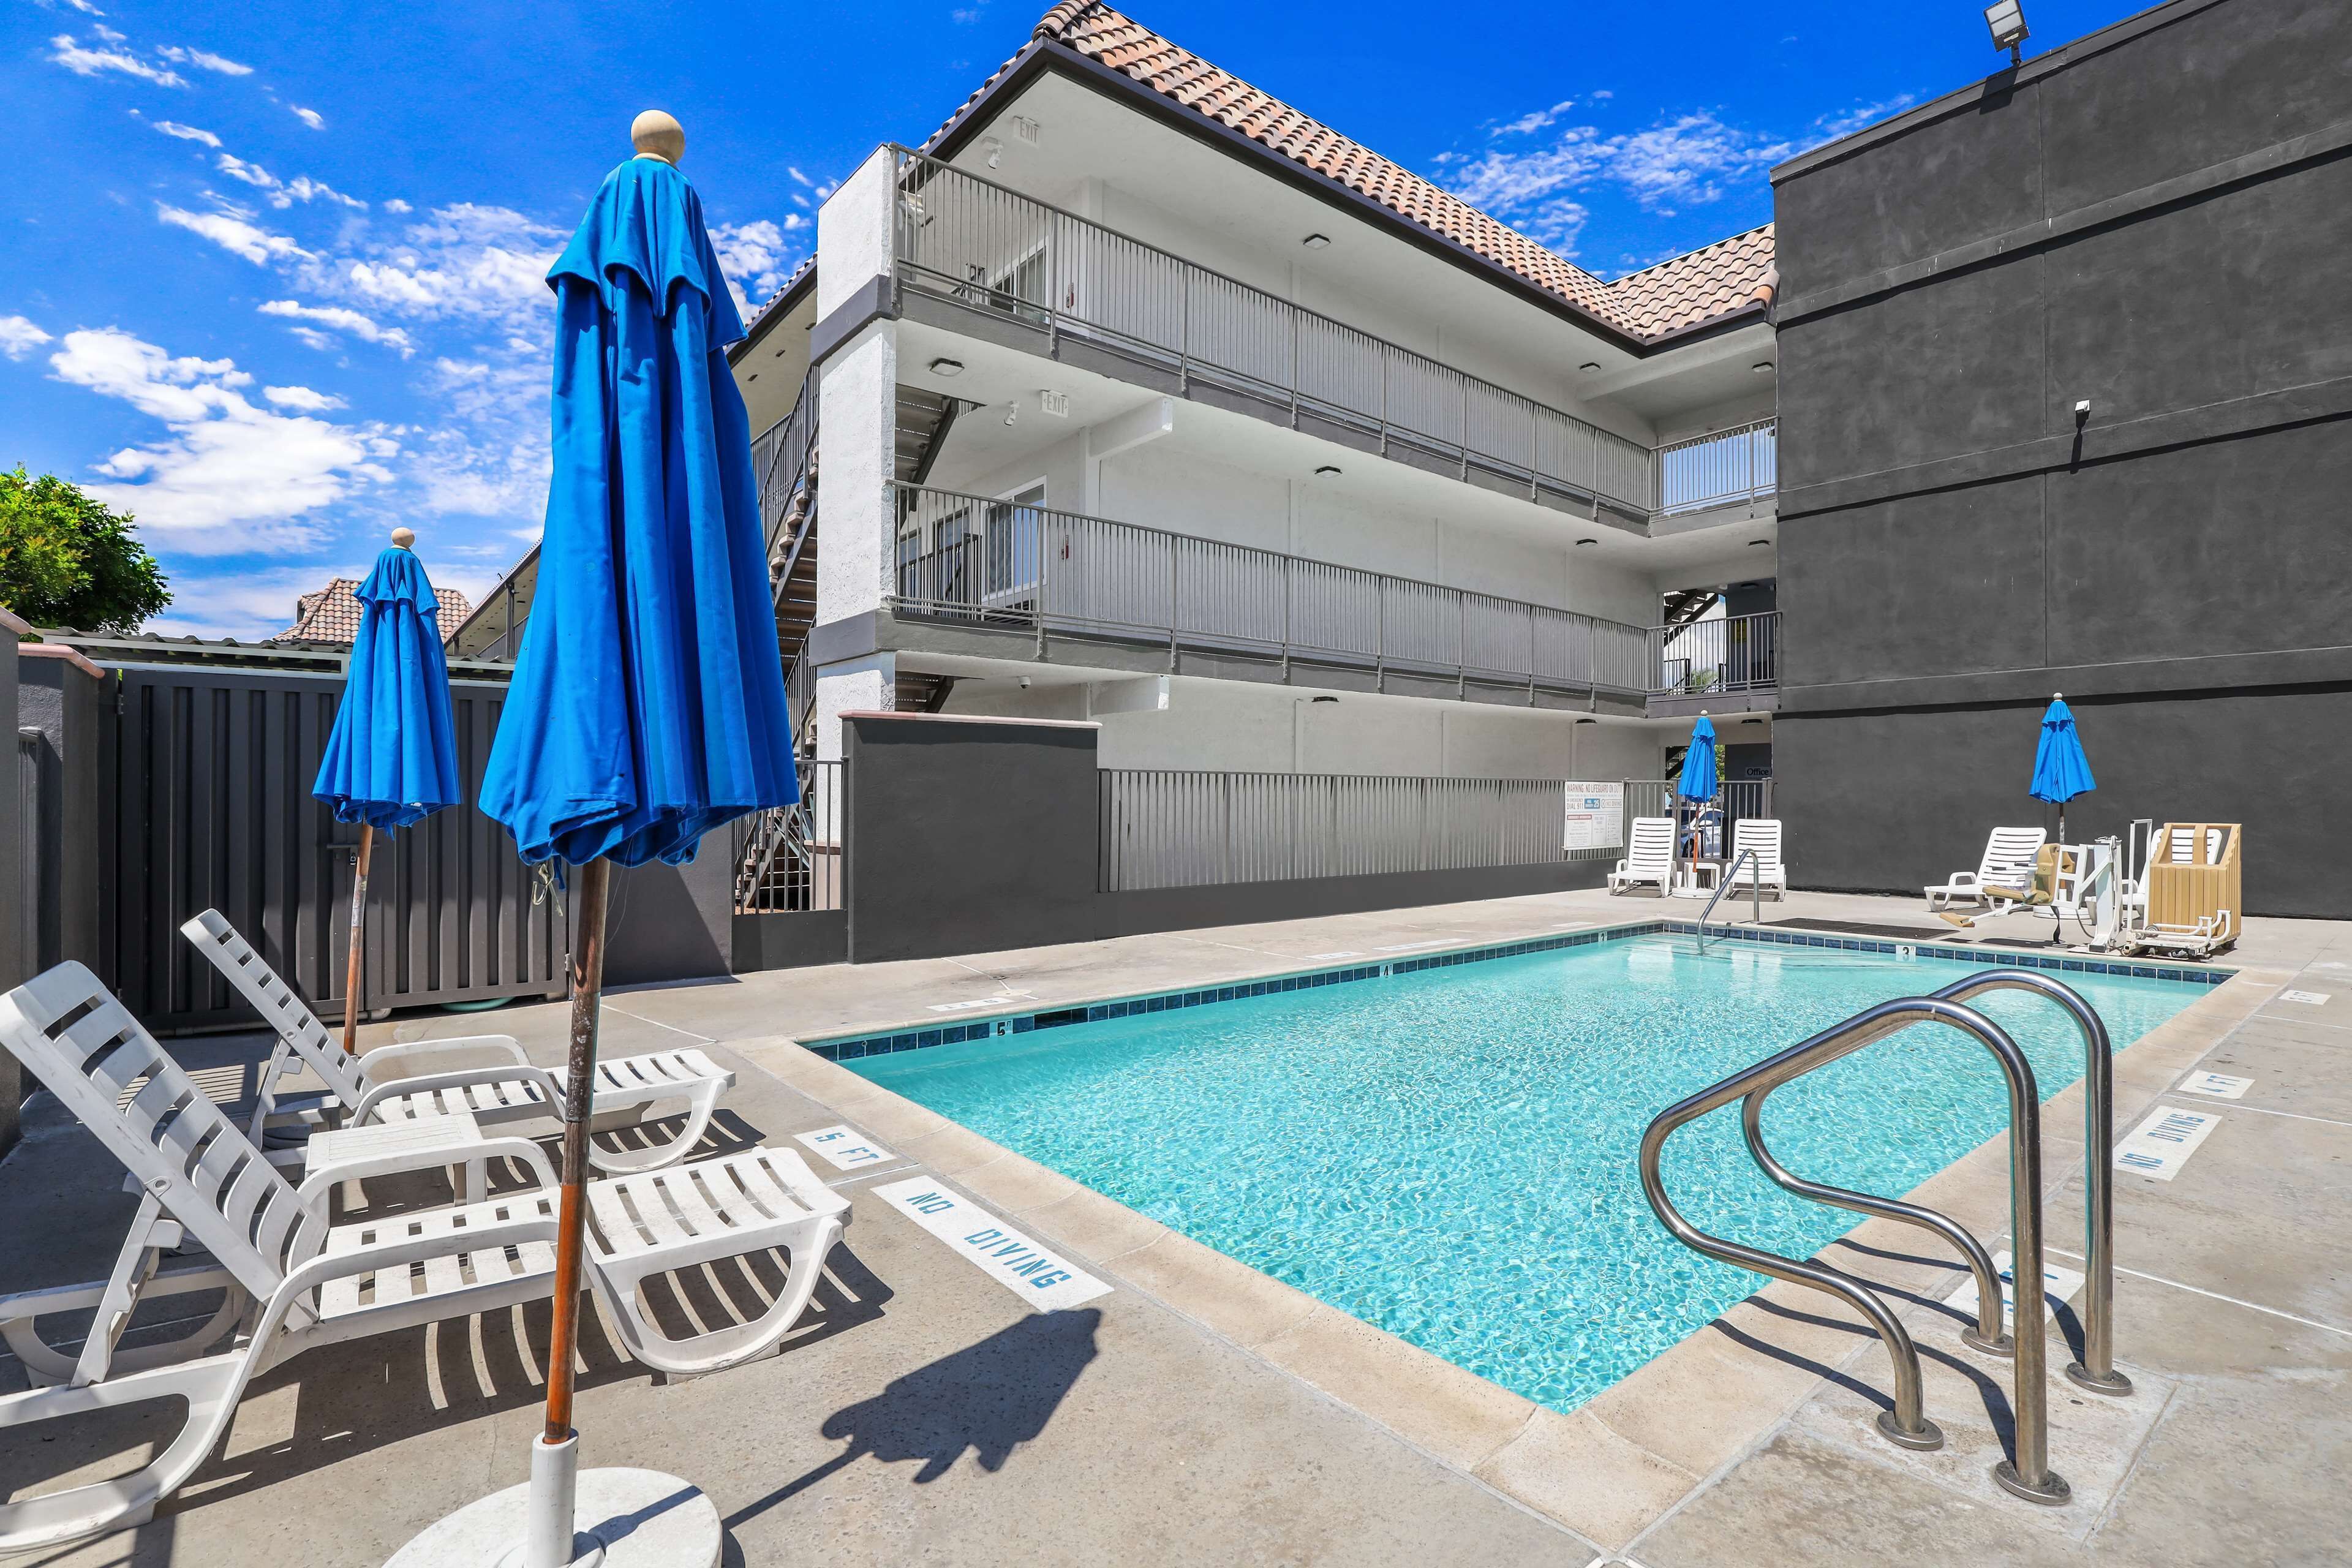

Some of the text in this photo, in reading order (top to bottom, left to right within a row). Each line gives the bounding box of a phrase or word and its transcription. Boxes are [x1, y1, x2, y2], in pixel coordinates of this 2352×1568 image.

[1019, 121, 1039, 143] EXIT
[1047, 393, 1065, 414] EXIT
[1585, 783, 1591, 793] NO
[1591, 783, 1608, 793] LIFEGUARD
[1608, 783, 1614, 793] ON
[1614, 783, 1623, 793] DUTY
[1594, 799, 1599, 808] 25
[997, 1022, 1006, 1036] 5
[814, 1131, 880, 1163] 5 FT
[2117, 1113, 2206, 1170] NO DIVING
[905, 1191, 1074, 1289] NO DIVING
